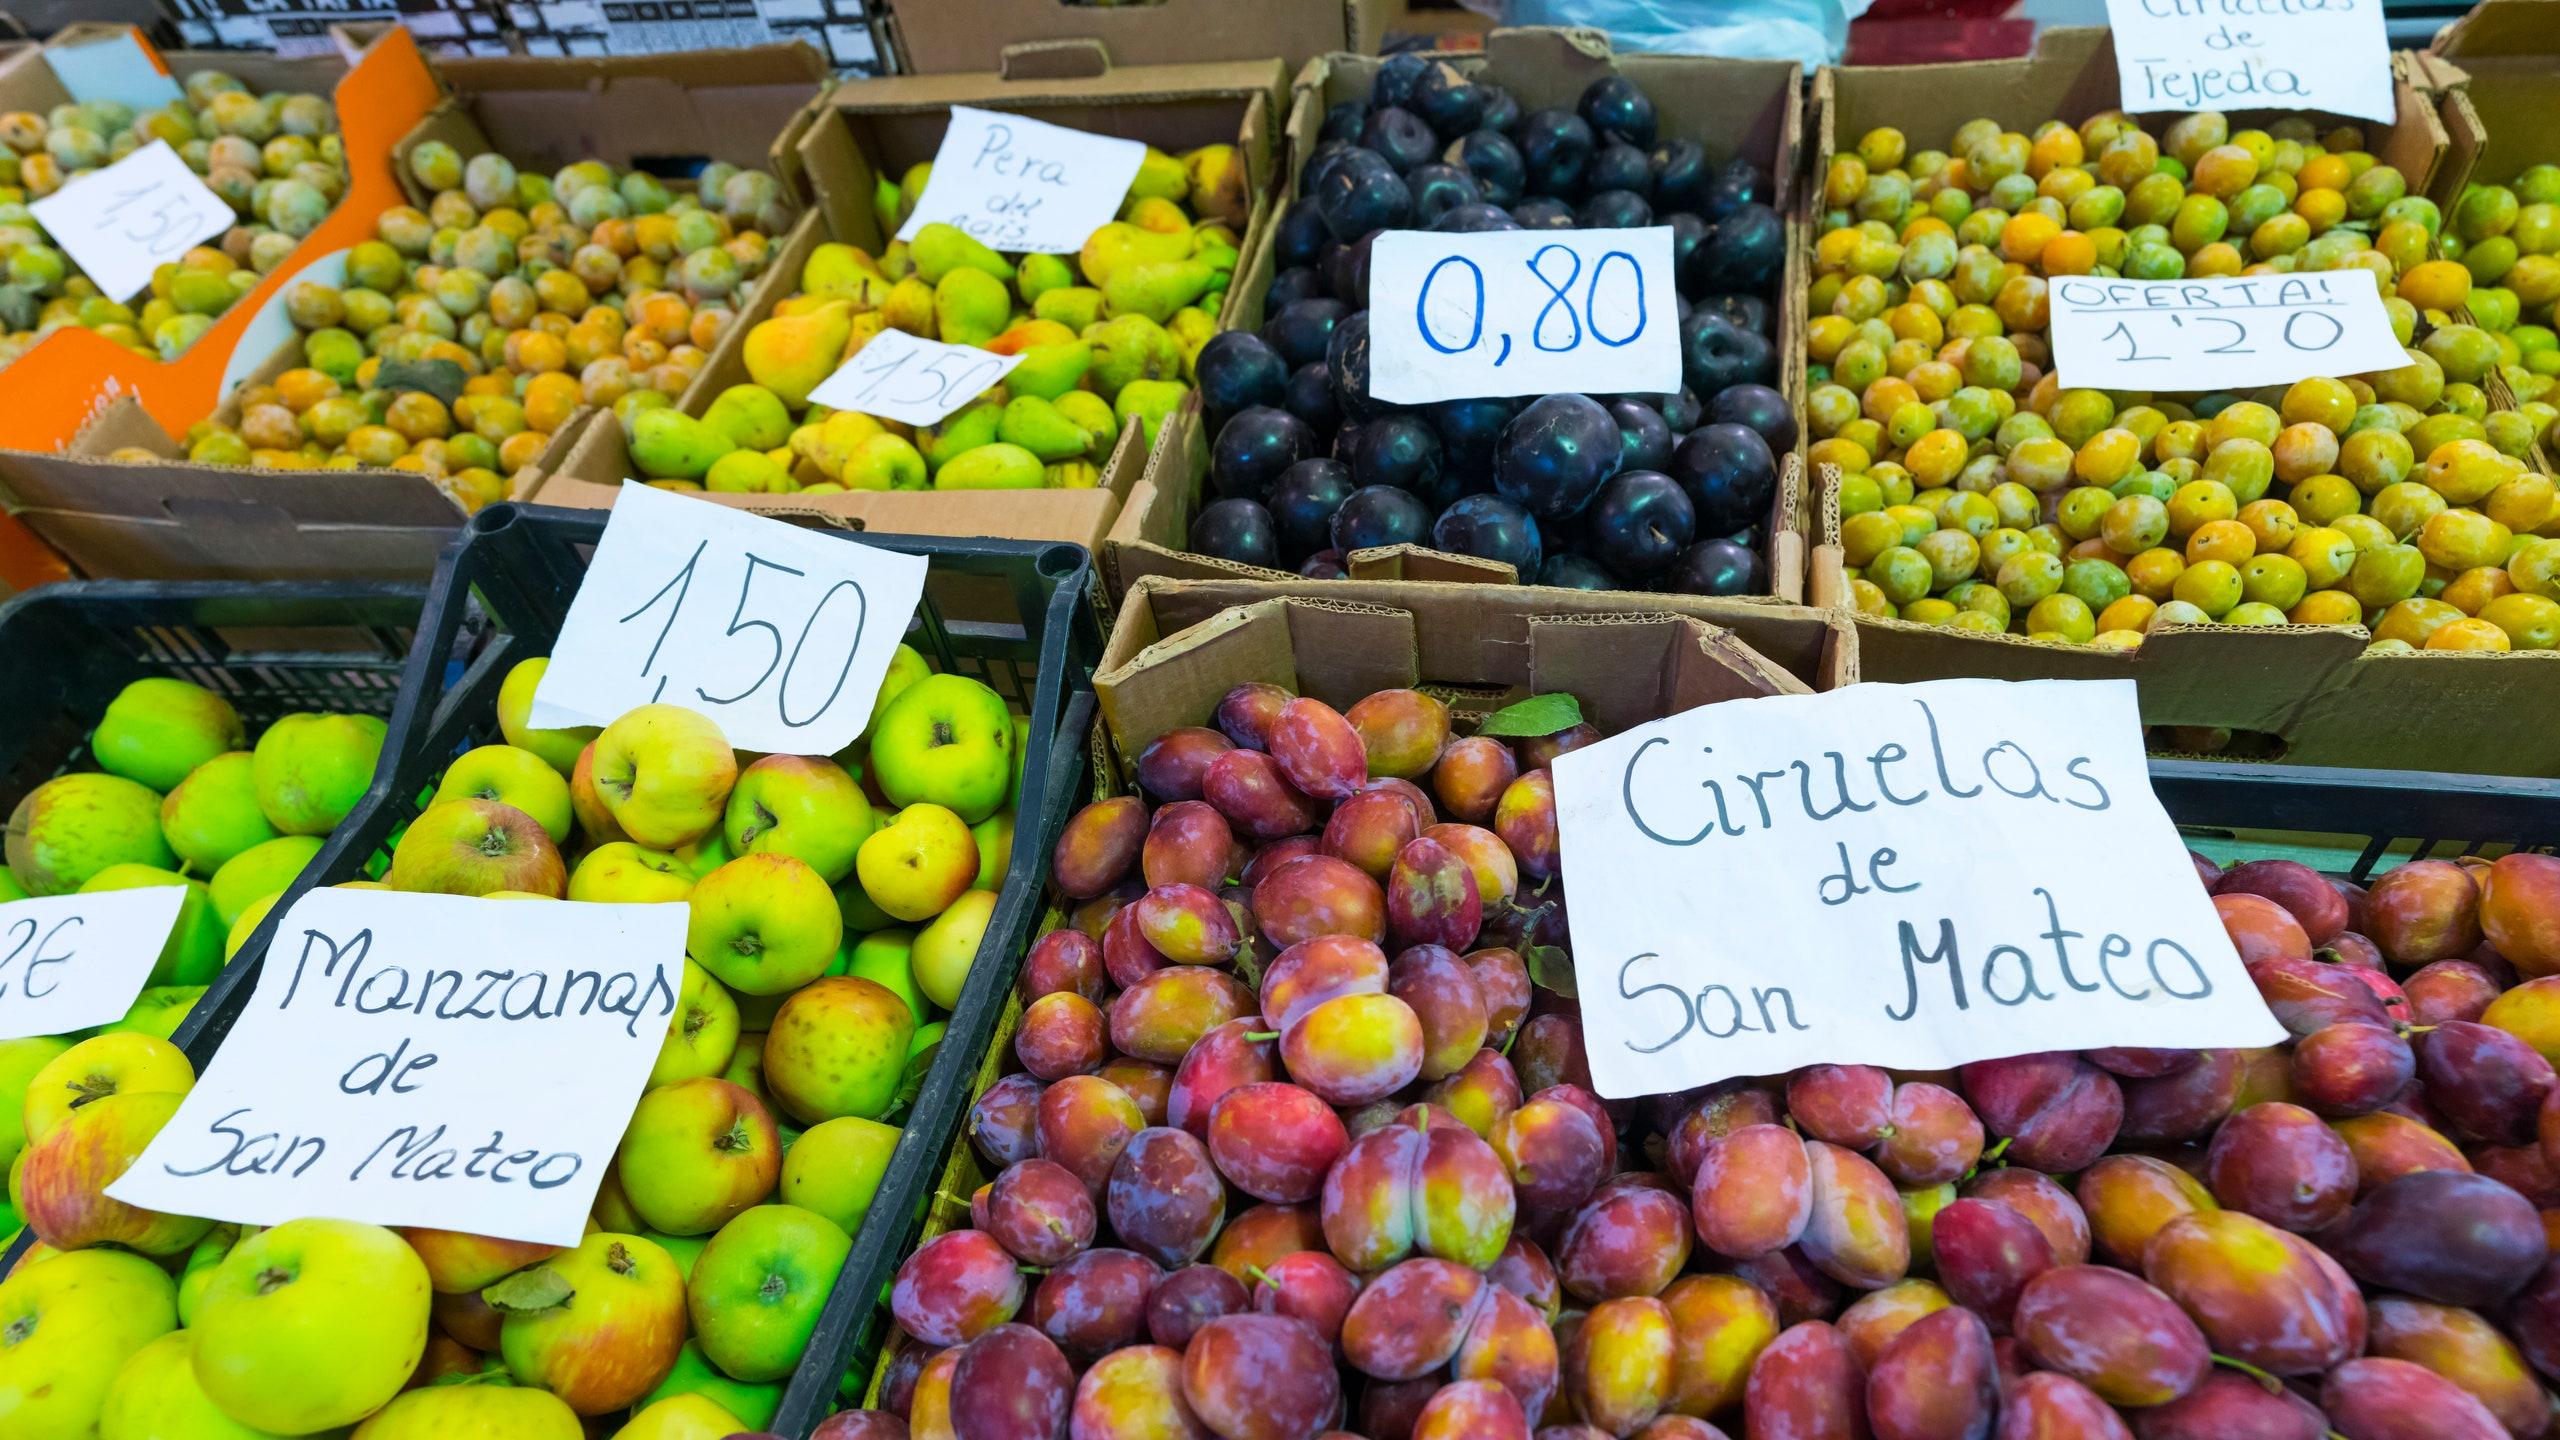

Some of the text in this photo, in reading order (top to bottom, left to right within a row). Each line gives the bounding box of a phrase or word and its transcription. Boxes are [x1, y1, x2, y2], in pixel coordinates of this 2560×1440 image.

[2205, 25, 2264, 51] de
[2133, 59, 2312, 107] Tejeda
[973, 123, 1070, 187] Pera
[94, 180, 206, 256] 1,50
[986, 192, 1042, 218] del
[1416, 244, 1647, 367] 0,80
[2060, 278, 2335, 308] OFERTA!
[2101, 309, 2345, 362] 1'20
[855, 348, 1004, 408] 1,50
[619, 539, 867, 728] 1,50
[1622, 698, 2112, 847] Ciruelas
[1818, 841, 1922, 906] de
[279, 927, 675, 1038] Manzanas
[1618, 887, 2213, 1054] San Mateo
[338, 1037, 439, 1096] de
[163, 1107, 583, 1190] San Mateo
